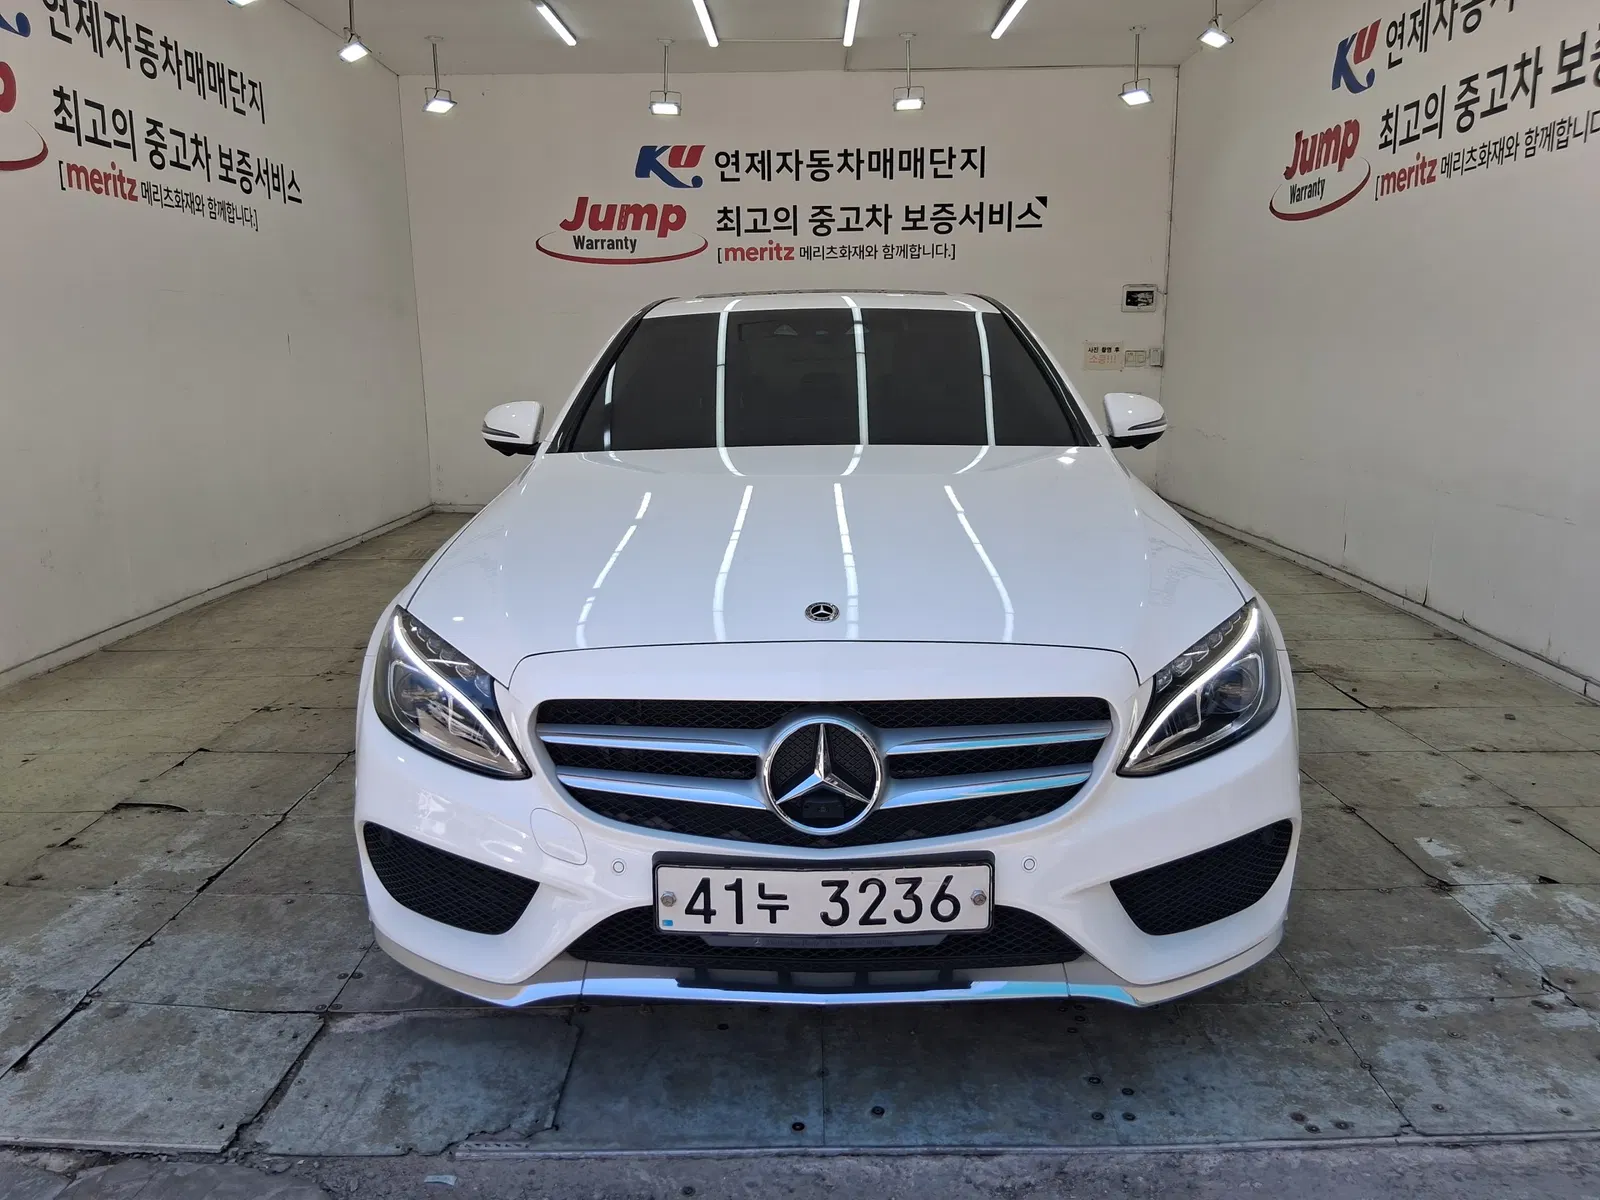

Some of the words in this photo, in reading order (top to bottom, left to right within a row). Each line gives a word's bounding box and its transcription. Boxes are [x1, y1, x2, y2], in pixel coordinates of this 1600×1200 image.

[1385, 0, 1515, 69] 연제자동
[42, 0, 266, 124] 연제자동차매매단지
[1378, 85, 1447, 154] 최고의
[1454, 45, 1543, 134] 중고차
[1551, 22, 1600, 95] 보
[52, 85, 138, 162] 최고의
[145, 116, 211, 182] 중고차
[218, 144, 303, 204] 보증서비스
[714, 146, 986, 182] 연제자동차매매단지
[1283, 118, 1360, 181] Jump
[1440, 132, 1519, 179] 메리츠화재와
[140, 181, 206, 217] 메리츠화재와
[1289, 178, 1326, 204] Warranty
[559, 197, 687, 238] Jump
[716, 205, 798, 237] 최고의
[808, 204, 893, 237] 중고차
[901, 201, 1043, 234] 보증서비스
[573, 235, 637, 254] Warranty
[799, 245, 878, 261] 메리츠화재와
[685, 877, 789, 925] 41누
[820, 875, 962, 926] 3236
